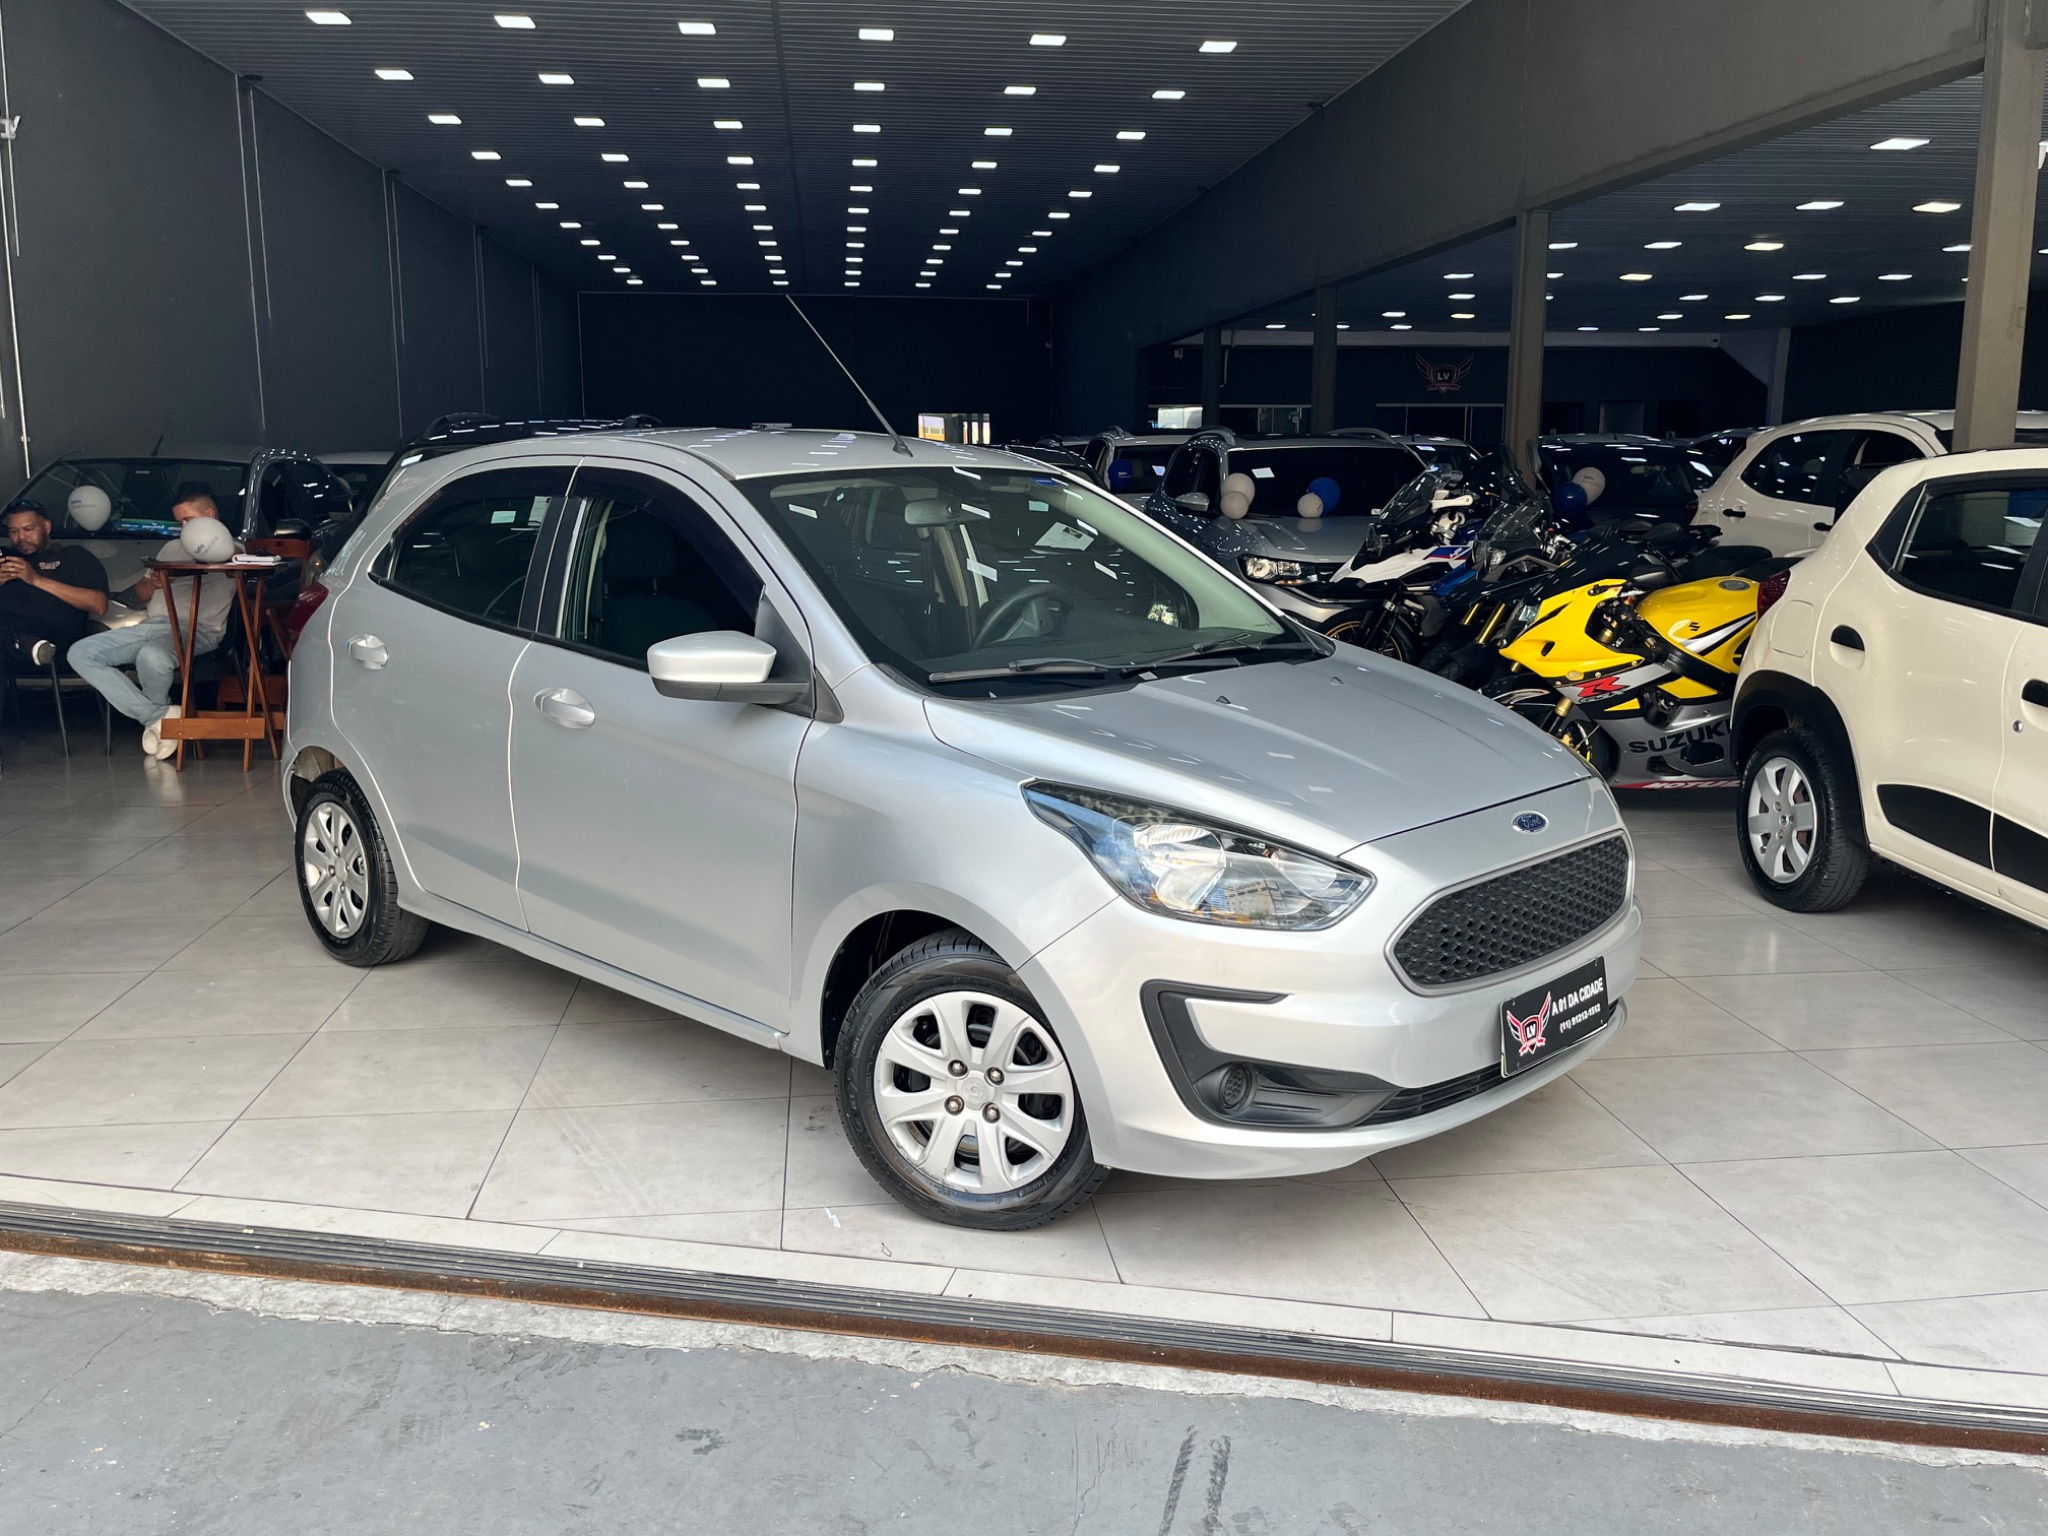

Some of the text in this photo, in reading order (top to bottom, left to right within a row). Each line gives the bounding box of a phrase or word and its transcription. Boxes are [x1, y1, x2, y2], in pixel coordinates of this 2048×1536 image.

[1436, 372, 1450, 381] LV
[1628, 718, 1731, 754] SUZUKI
[1517, 815, 1542, 828] Ford
[1552, 977, 1604, 1016] A 01 DA CIDADE
[1527, 1024, 1536, 1038] LV
[1559, 1018, 1572, 1034] (11)
